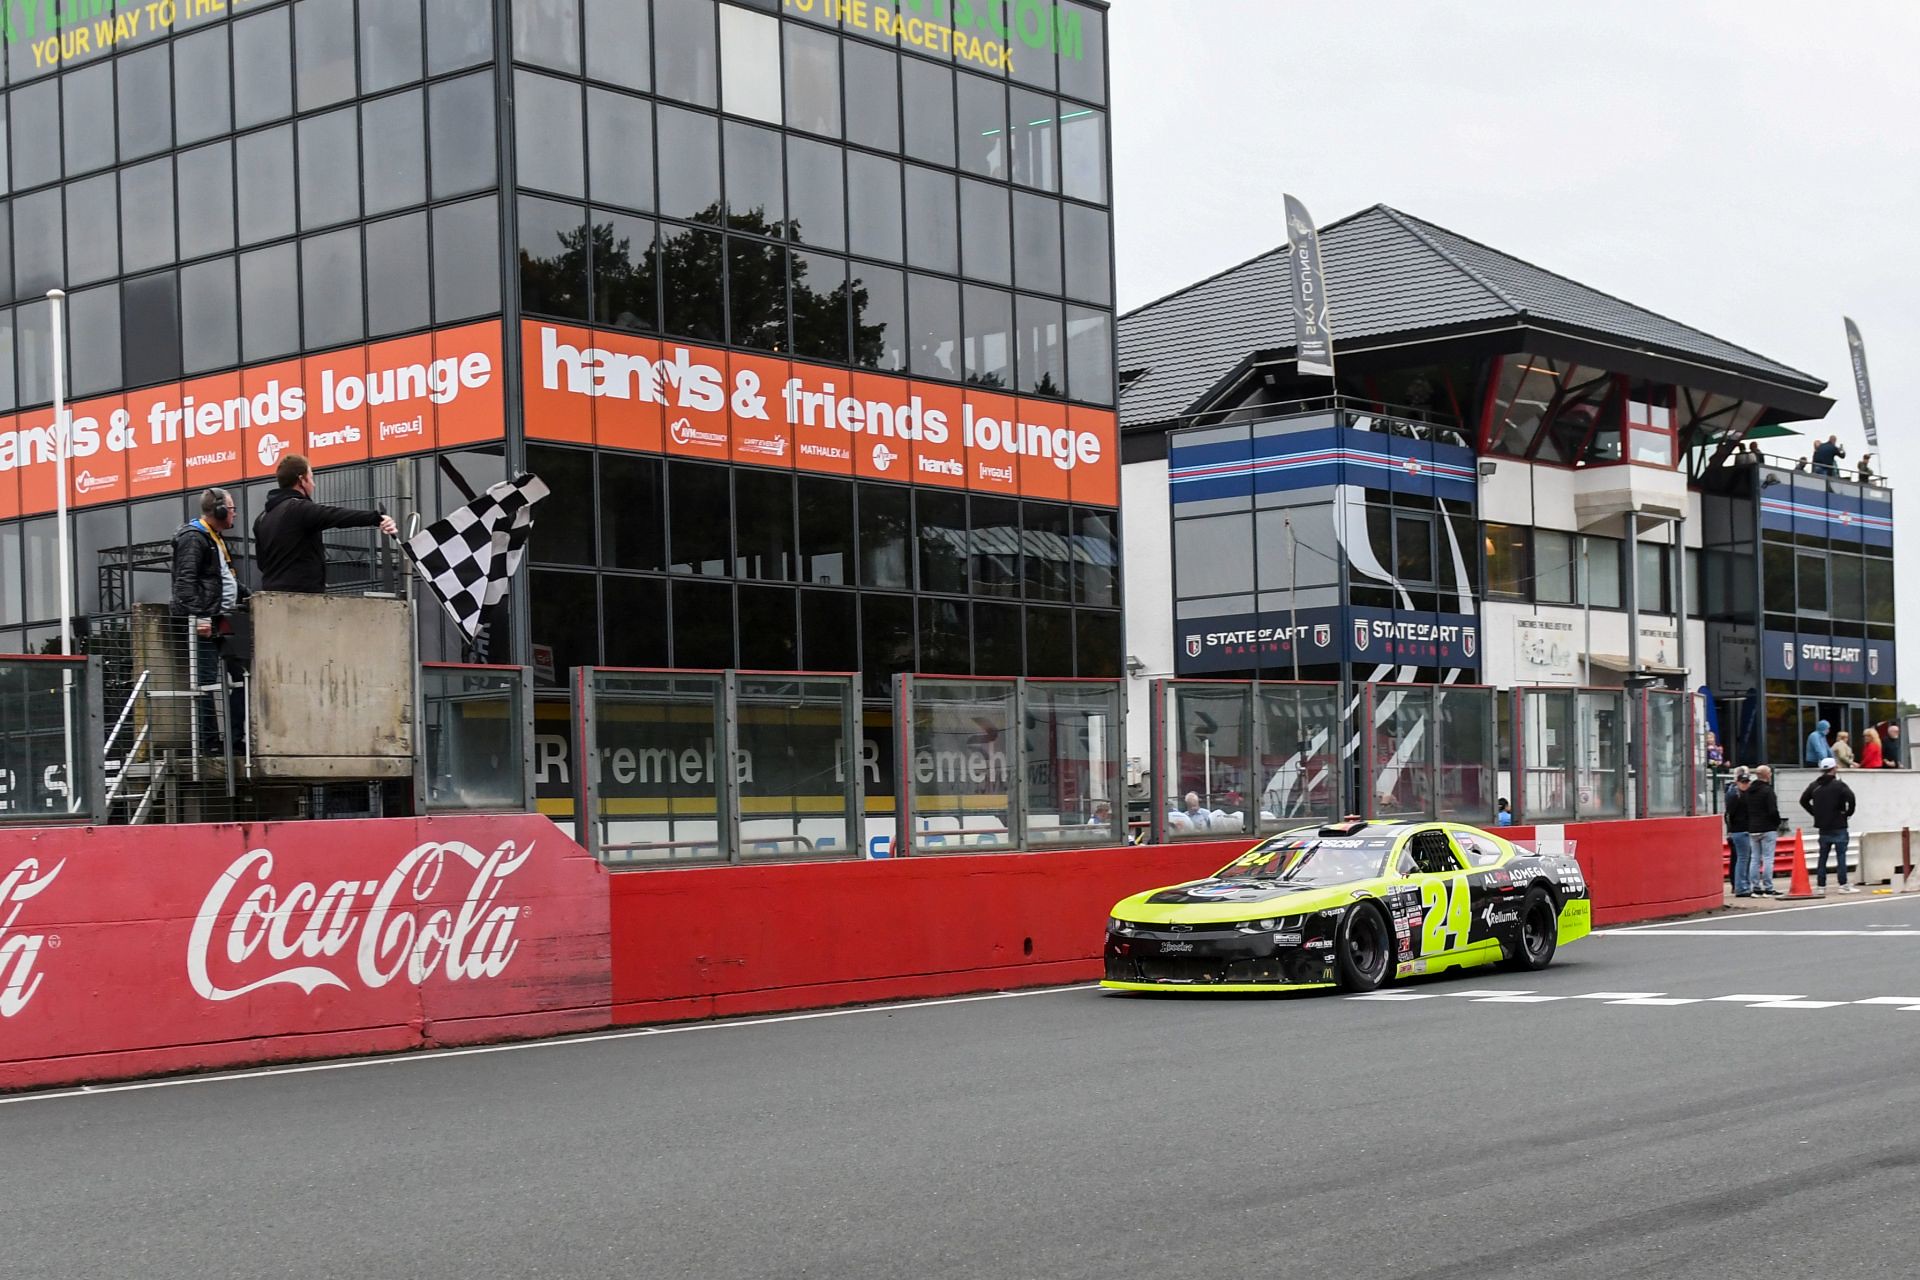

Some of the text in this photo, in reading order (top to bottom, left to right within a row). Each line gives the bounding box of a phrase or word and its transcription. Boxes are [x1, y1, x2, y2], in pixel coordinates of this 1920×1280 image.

[32, 27, 90, 68] YOUR
[95, 8, 140, 49] WAY
[145, 0, 176, 31] TO
[874, 6, 1014, 72] RACETRACK
[541, 327, 1100, 470] hands & friends lounge
[0, 352, 491, 471] ands & friends lounge
[1206, 626, 1309, 646] STATE OF ART
[1372, 620, 1460, 644] STATE OF ART
[1225, 642, 1291, 655] RACING
[1385, 642, 1450, 657] RACING
[1802, 644, 1832, 660] STATE
[1841, 648, 1860, 662] ART
[1236, 851, 1277, 867] 24
[1512, 880, 1528, 888] GROUP
[187, 839, 536, 1000] Coca-Cola
[1421, 875, 1473, 957] 24
